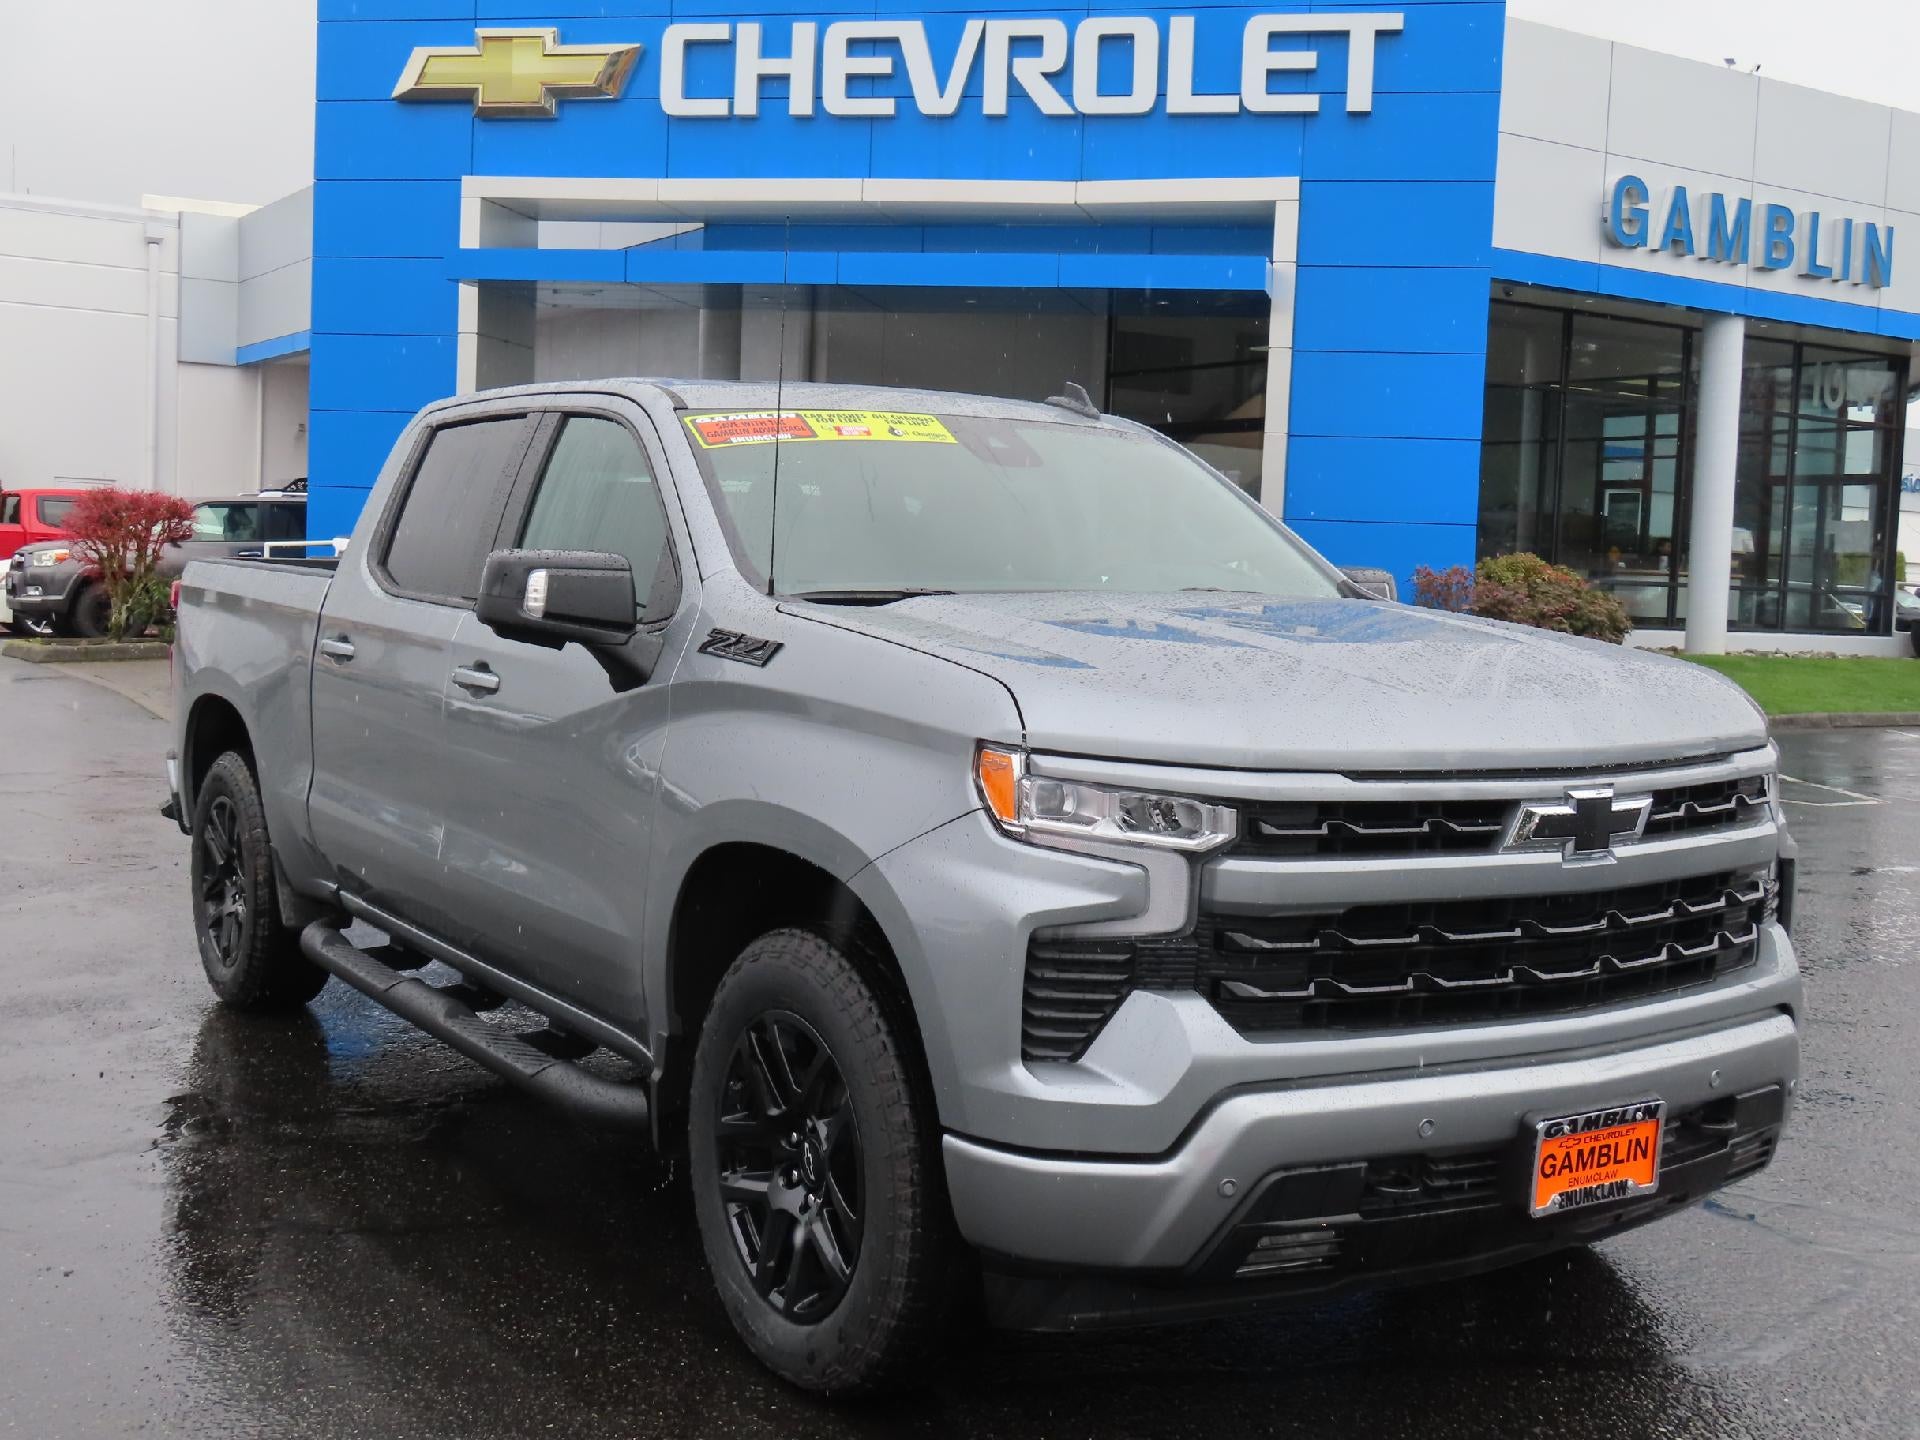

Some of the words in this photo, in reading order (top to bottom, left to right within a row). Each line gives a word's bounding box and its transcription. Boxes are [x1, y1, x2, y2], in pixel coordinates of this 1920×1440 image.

[660, 12, 1404, 118] CHEVROLET
[1603, 174, 1895, 289] GAMBLIN
[707, 428, 750, 437] GAMBLIN
[697, 627, 785, 667] Z71
[1543, 1103, 1661, 1139] GAMBLIN
[1583, 1127, 1637, 1144] CHEVROLET
[1540, 1136, 1650, 1179] GAMBLIN
[1558, 1178, 1629, 1210] ENUMCLAW
[1568, 1169, 1619, 1188] ENUMCLAW
